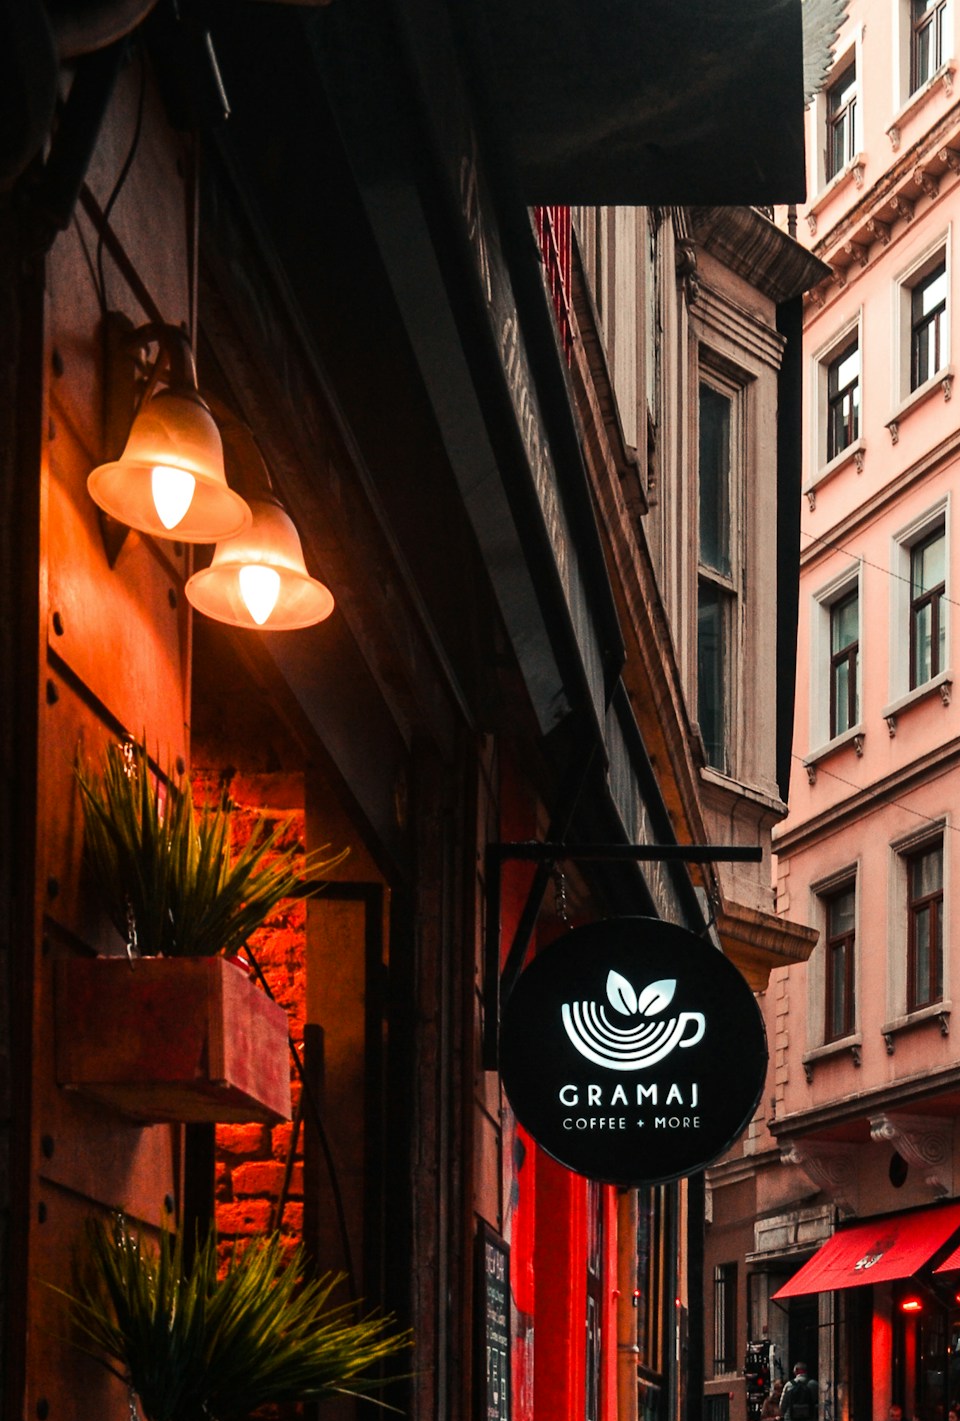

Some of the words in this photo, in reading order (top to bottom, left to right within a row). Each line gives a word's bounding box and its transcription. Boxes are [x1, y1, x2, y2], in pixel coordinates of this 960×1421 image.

[559, 1083, 699, 1107] GRAMAJ
[563, 1117, 626, 1130] COFFEE
[654, 1116, 701, 1129] MORE
